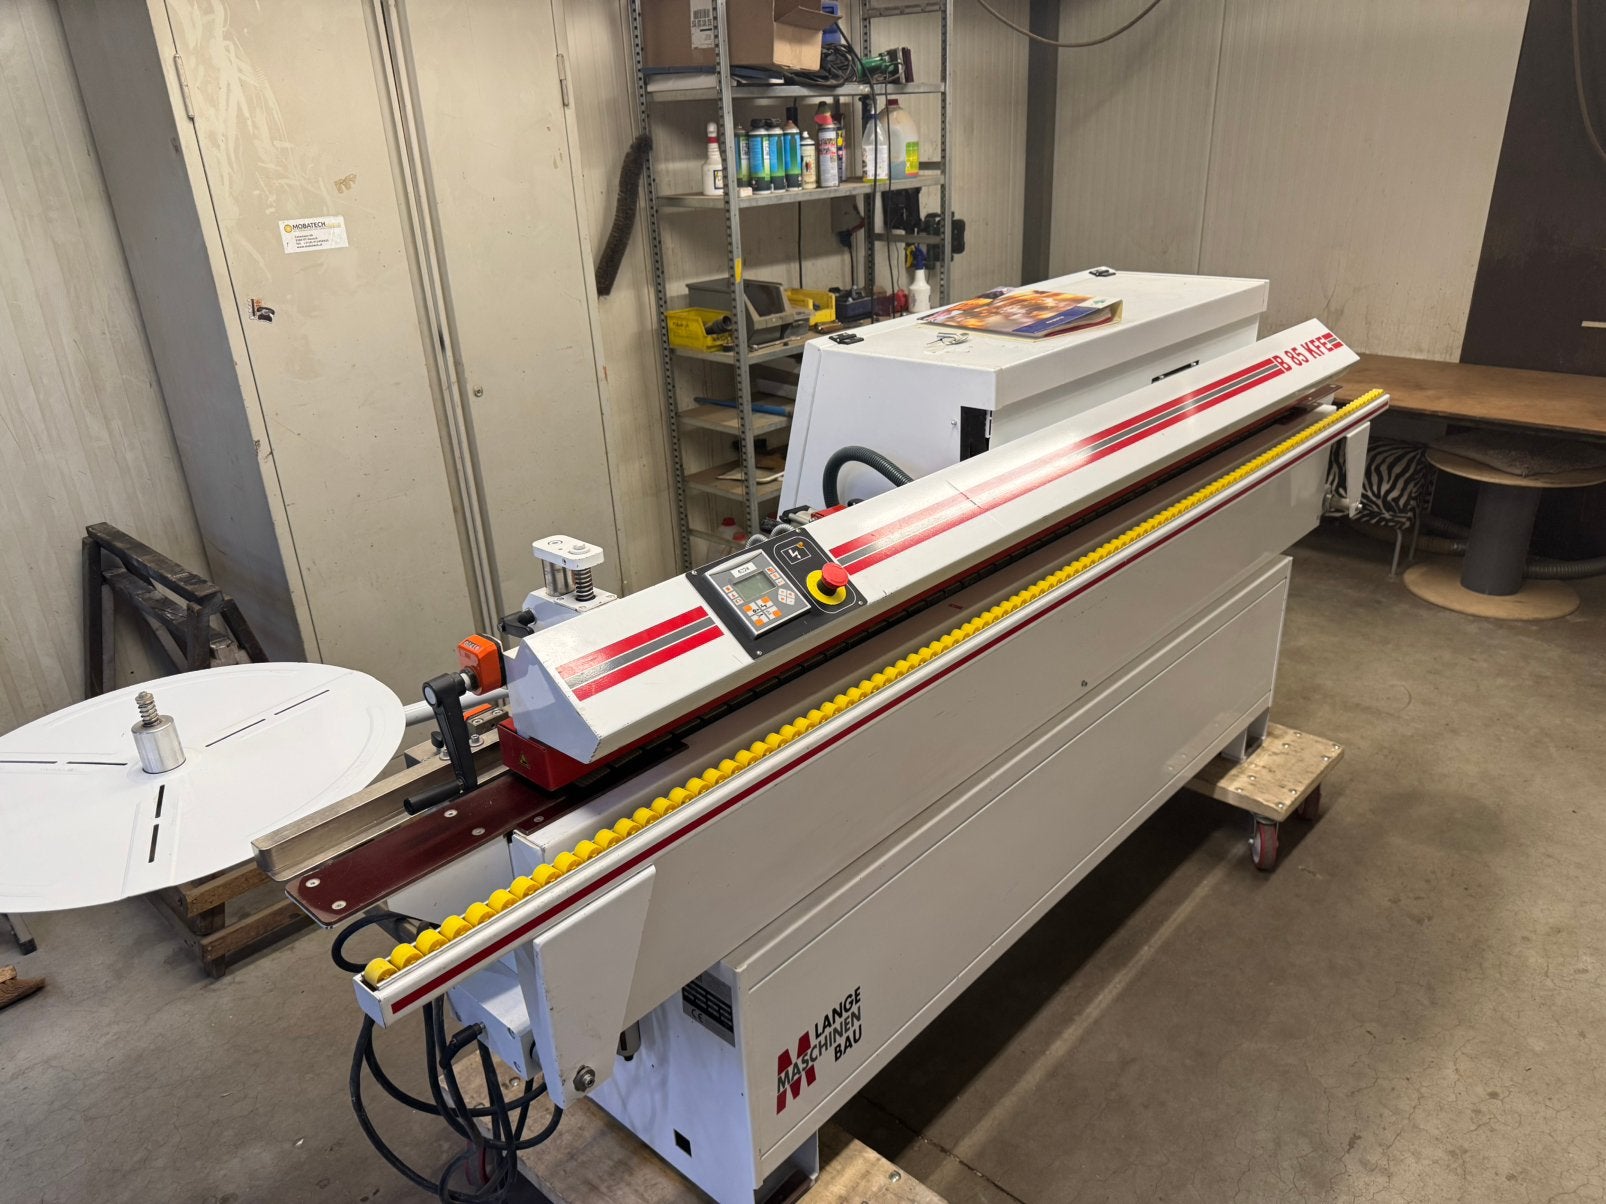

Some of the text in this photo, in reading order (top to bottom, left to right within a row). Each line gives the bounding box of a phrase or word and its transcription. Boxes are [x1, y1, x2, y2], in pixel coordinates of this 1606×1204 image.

[292, 221, 326, 230] MOBATECH
[1272, 335, 1334, 372] B 85 KFE
[814, 986, 861, 1039] LANGE
[776, 1006, 861, 1094] MASCHINEN
[834, 1024, 863, 1063] BAU
